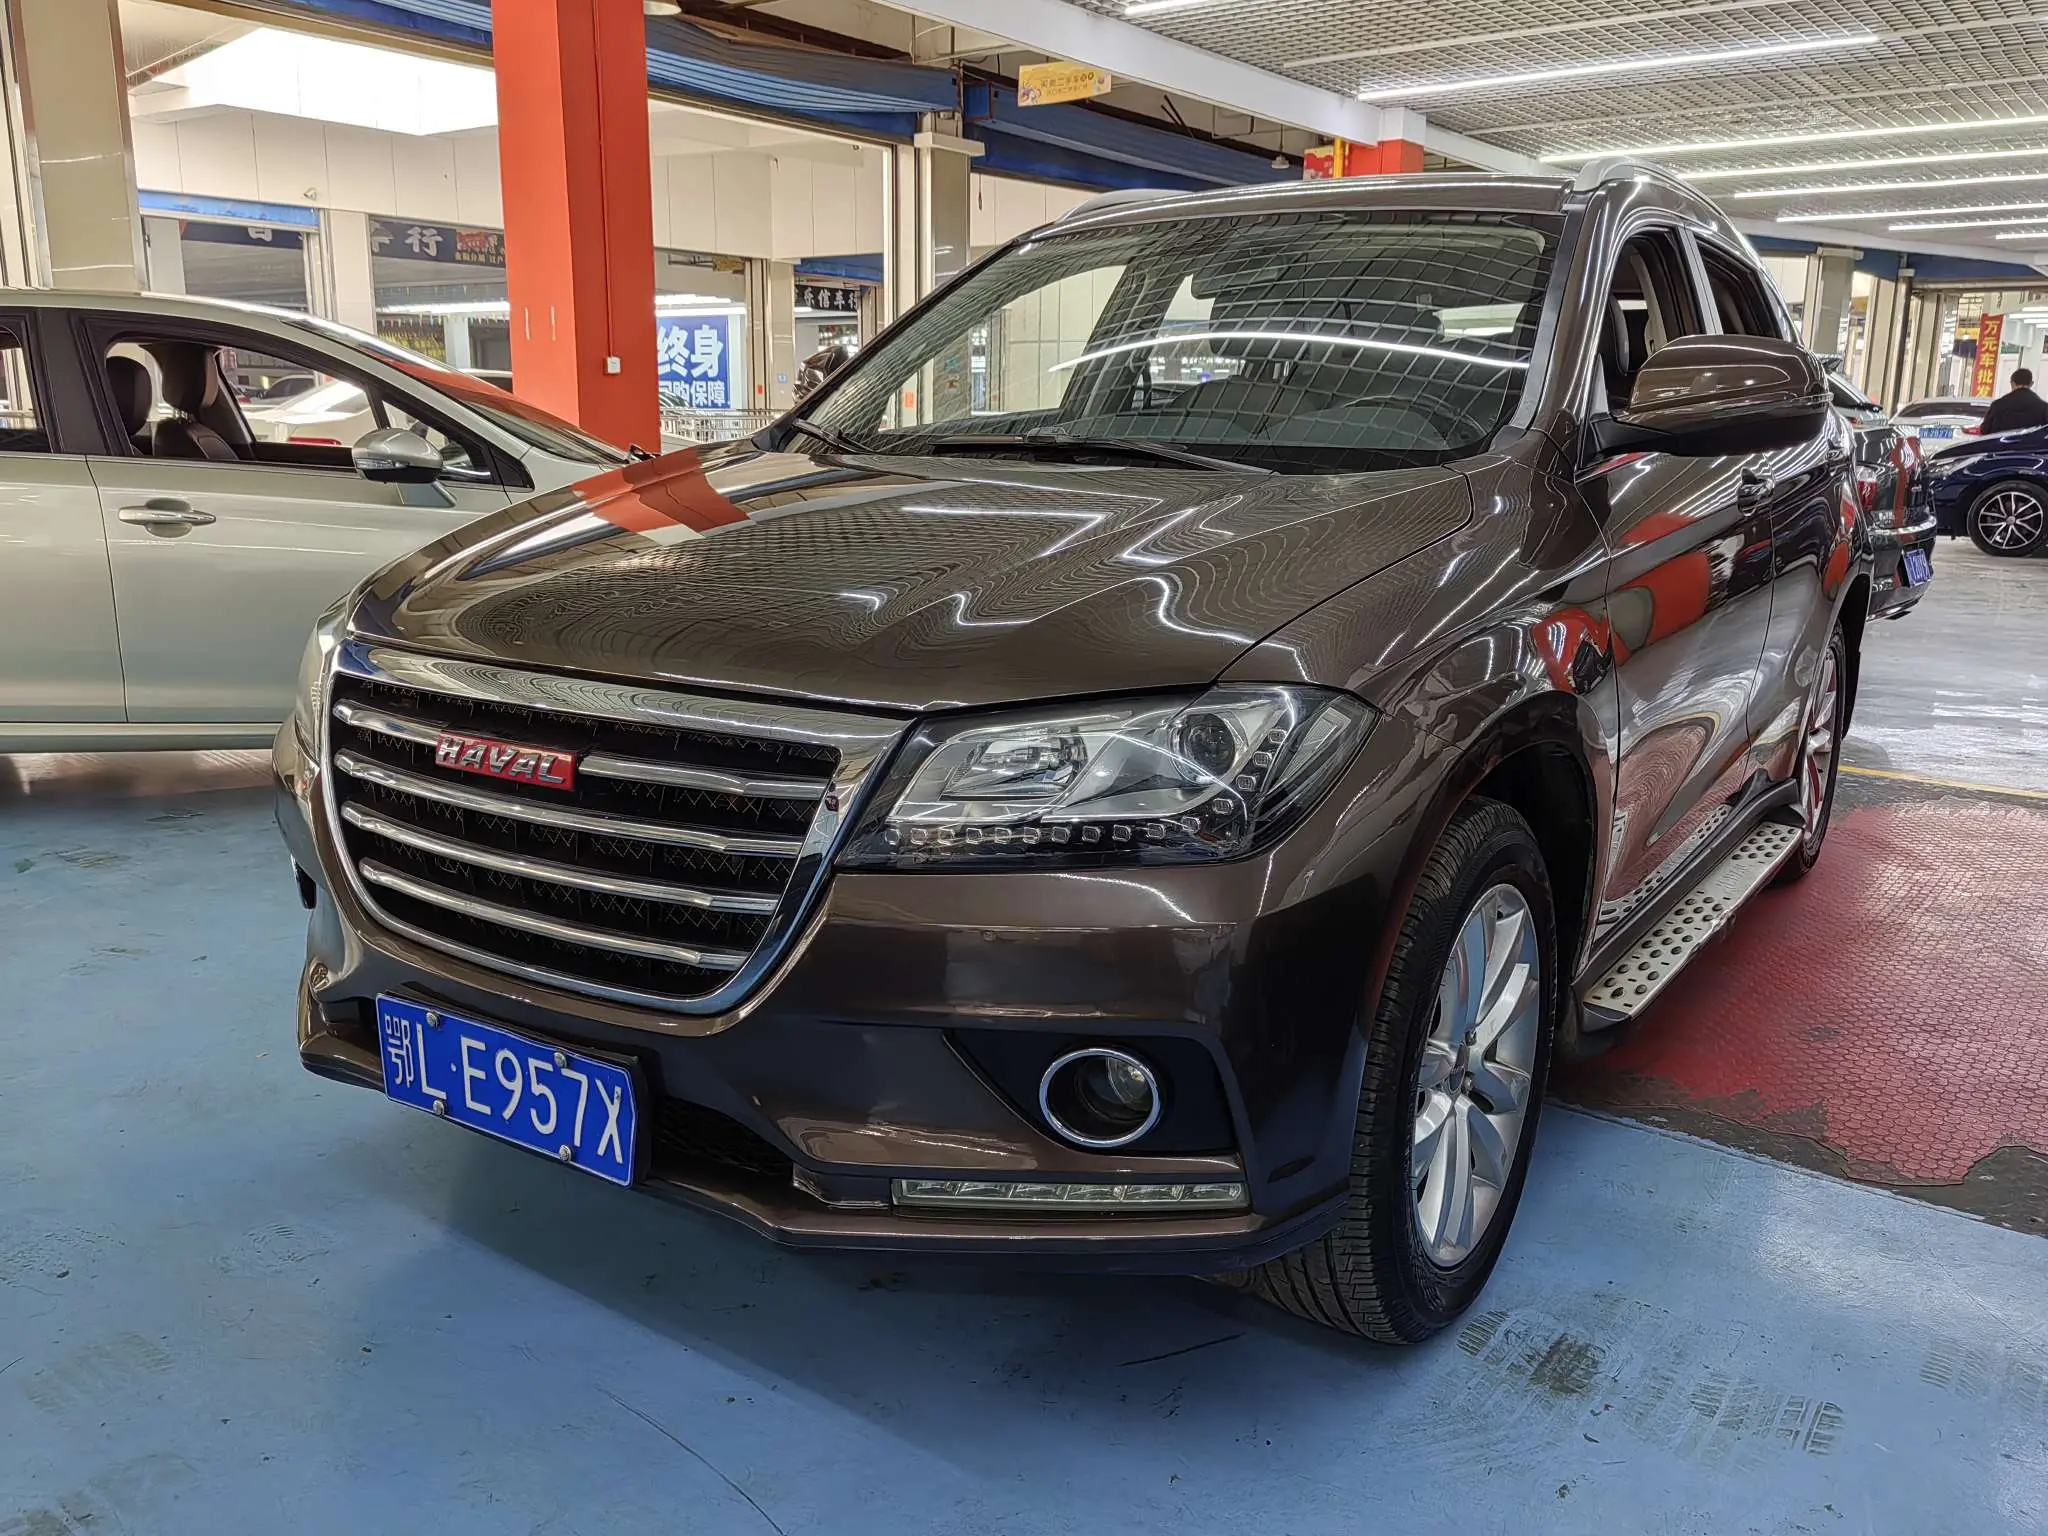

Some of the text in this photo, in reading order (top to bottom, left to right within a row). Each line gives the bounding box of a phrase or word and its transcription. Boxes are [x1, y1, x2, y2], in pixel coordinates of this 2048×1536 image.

[657, 324, 724, 378] 终身
[1975, 320, 2001, 398] 万元车批发
[436, 736, 565, 784] HAVAL
[384, 1012, 624, 1165] 鄂L·E957X
